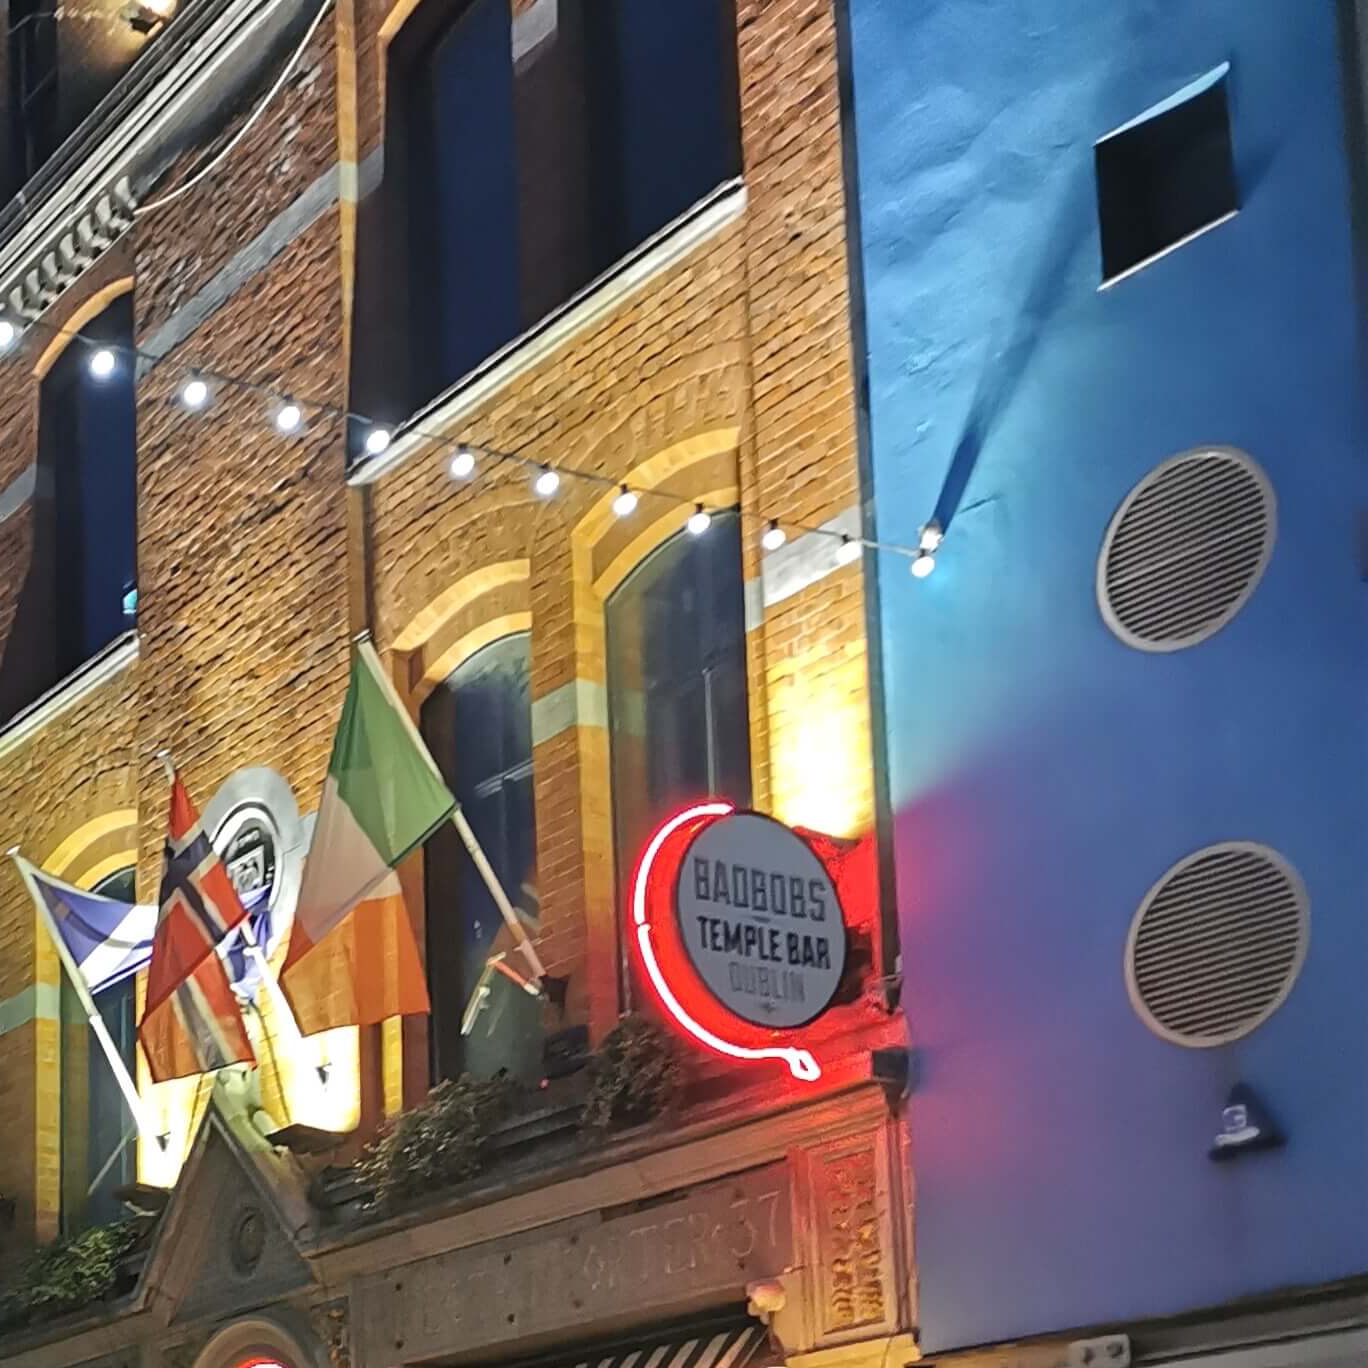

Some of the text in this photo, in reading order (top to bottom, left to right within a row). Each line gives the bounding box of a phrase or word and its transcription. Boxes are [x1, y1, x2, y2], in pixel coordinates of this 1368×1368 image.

[694, 857, 825, 922] BADBOBS
[697, 916, 831, 970] TEMPLE BAR
[729, 961, 806, 1002] DUBLIN
